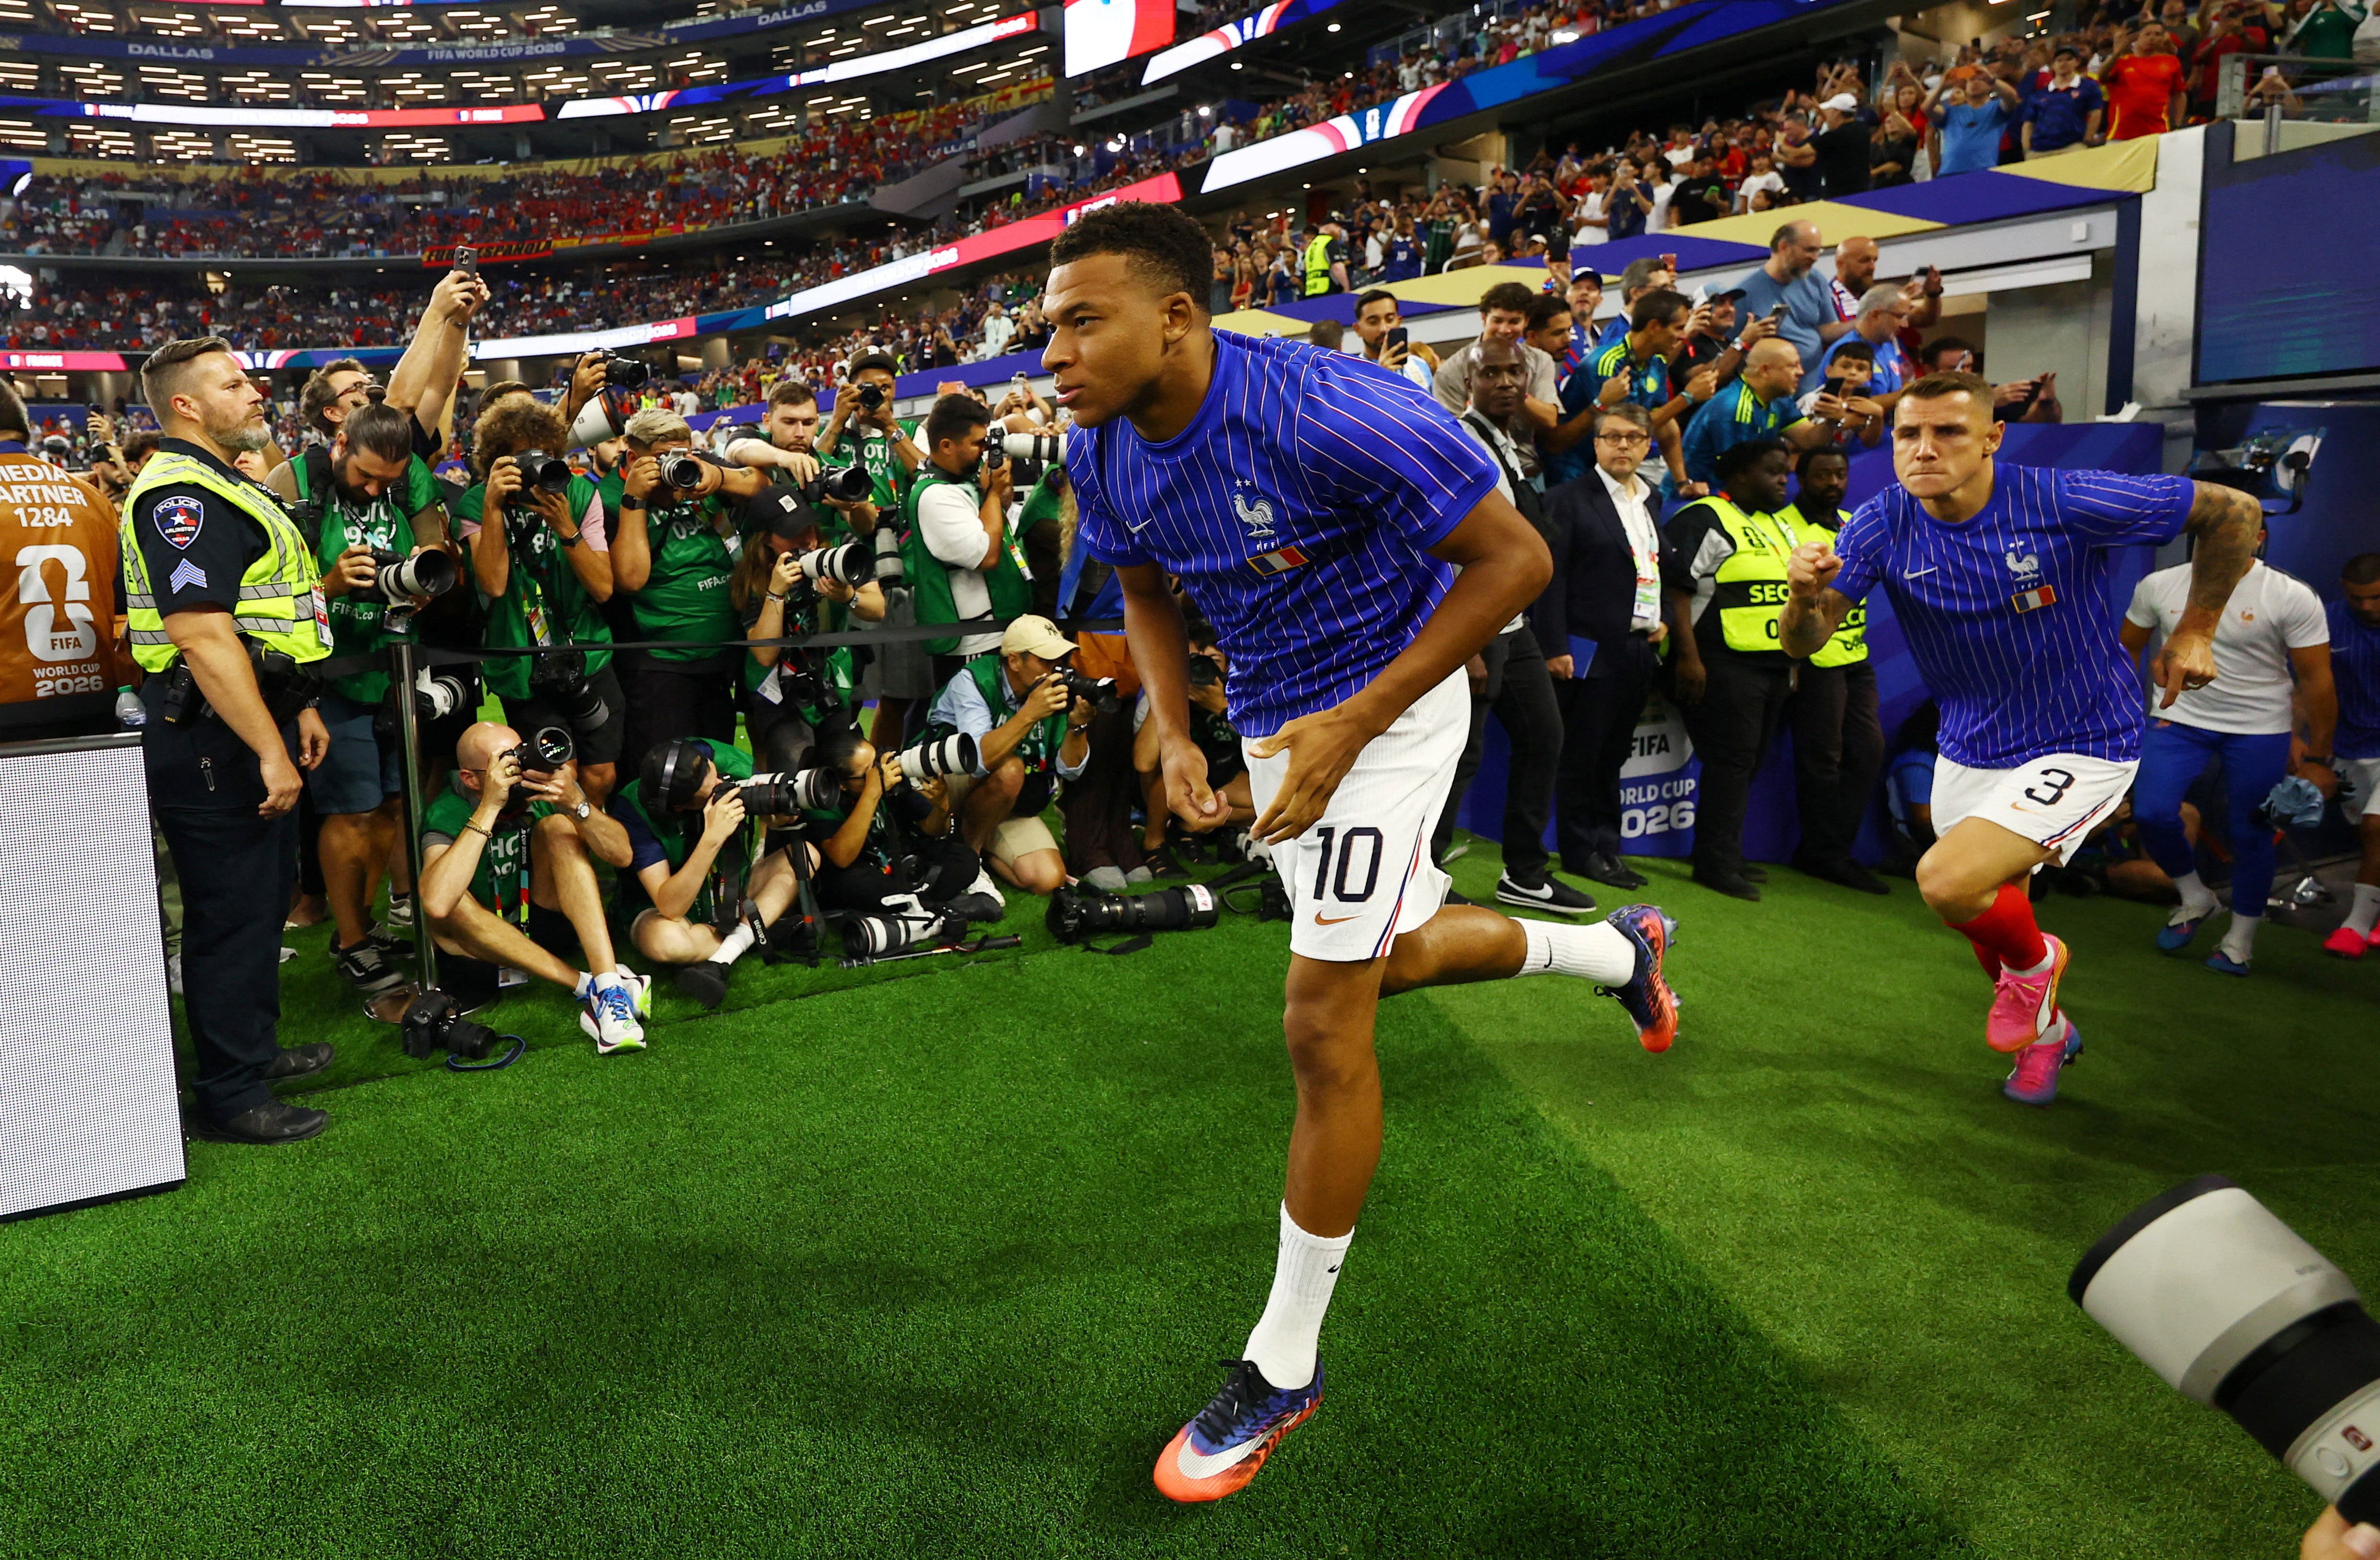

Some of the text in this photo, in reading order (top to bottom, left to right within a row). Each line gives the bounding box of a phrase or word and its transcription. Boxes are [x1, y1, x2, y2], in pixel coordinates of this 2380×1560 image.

[757, 1, 827, 26] DALLAS
[128, 43, 214, 60] DALLAS
[428, 41, 565, 60] FIFA WORLD CUP 2026
[0, 484, 88, 507] ARTNER
[158, 499, 199, 513] POLICE
[13, 507, 73, 528] 1284
[50, 637, 82, 651] FIFA
[33, 663, 100, 679] WORLD CUP
[35, 675, 104, 698] 2026
[1620, 778, 1696, 806] RLD CUP
[2025, 768, 2076, 806] 3
[1620, 800, 1695, 839] 026
[1313, 827, 1383, 902] 10
[753, 919, 767, 945] Canon
